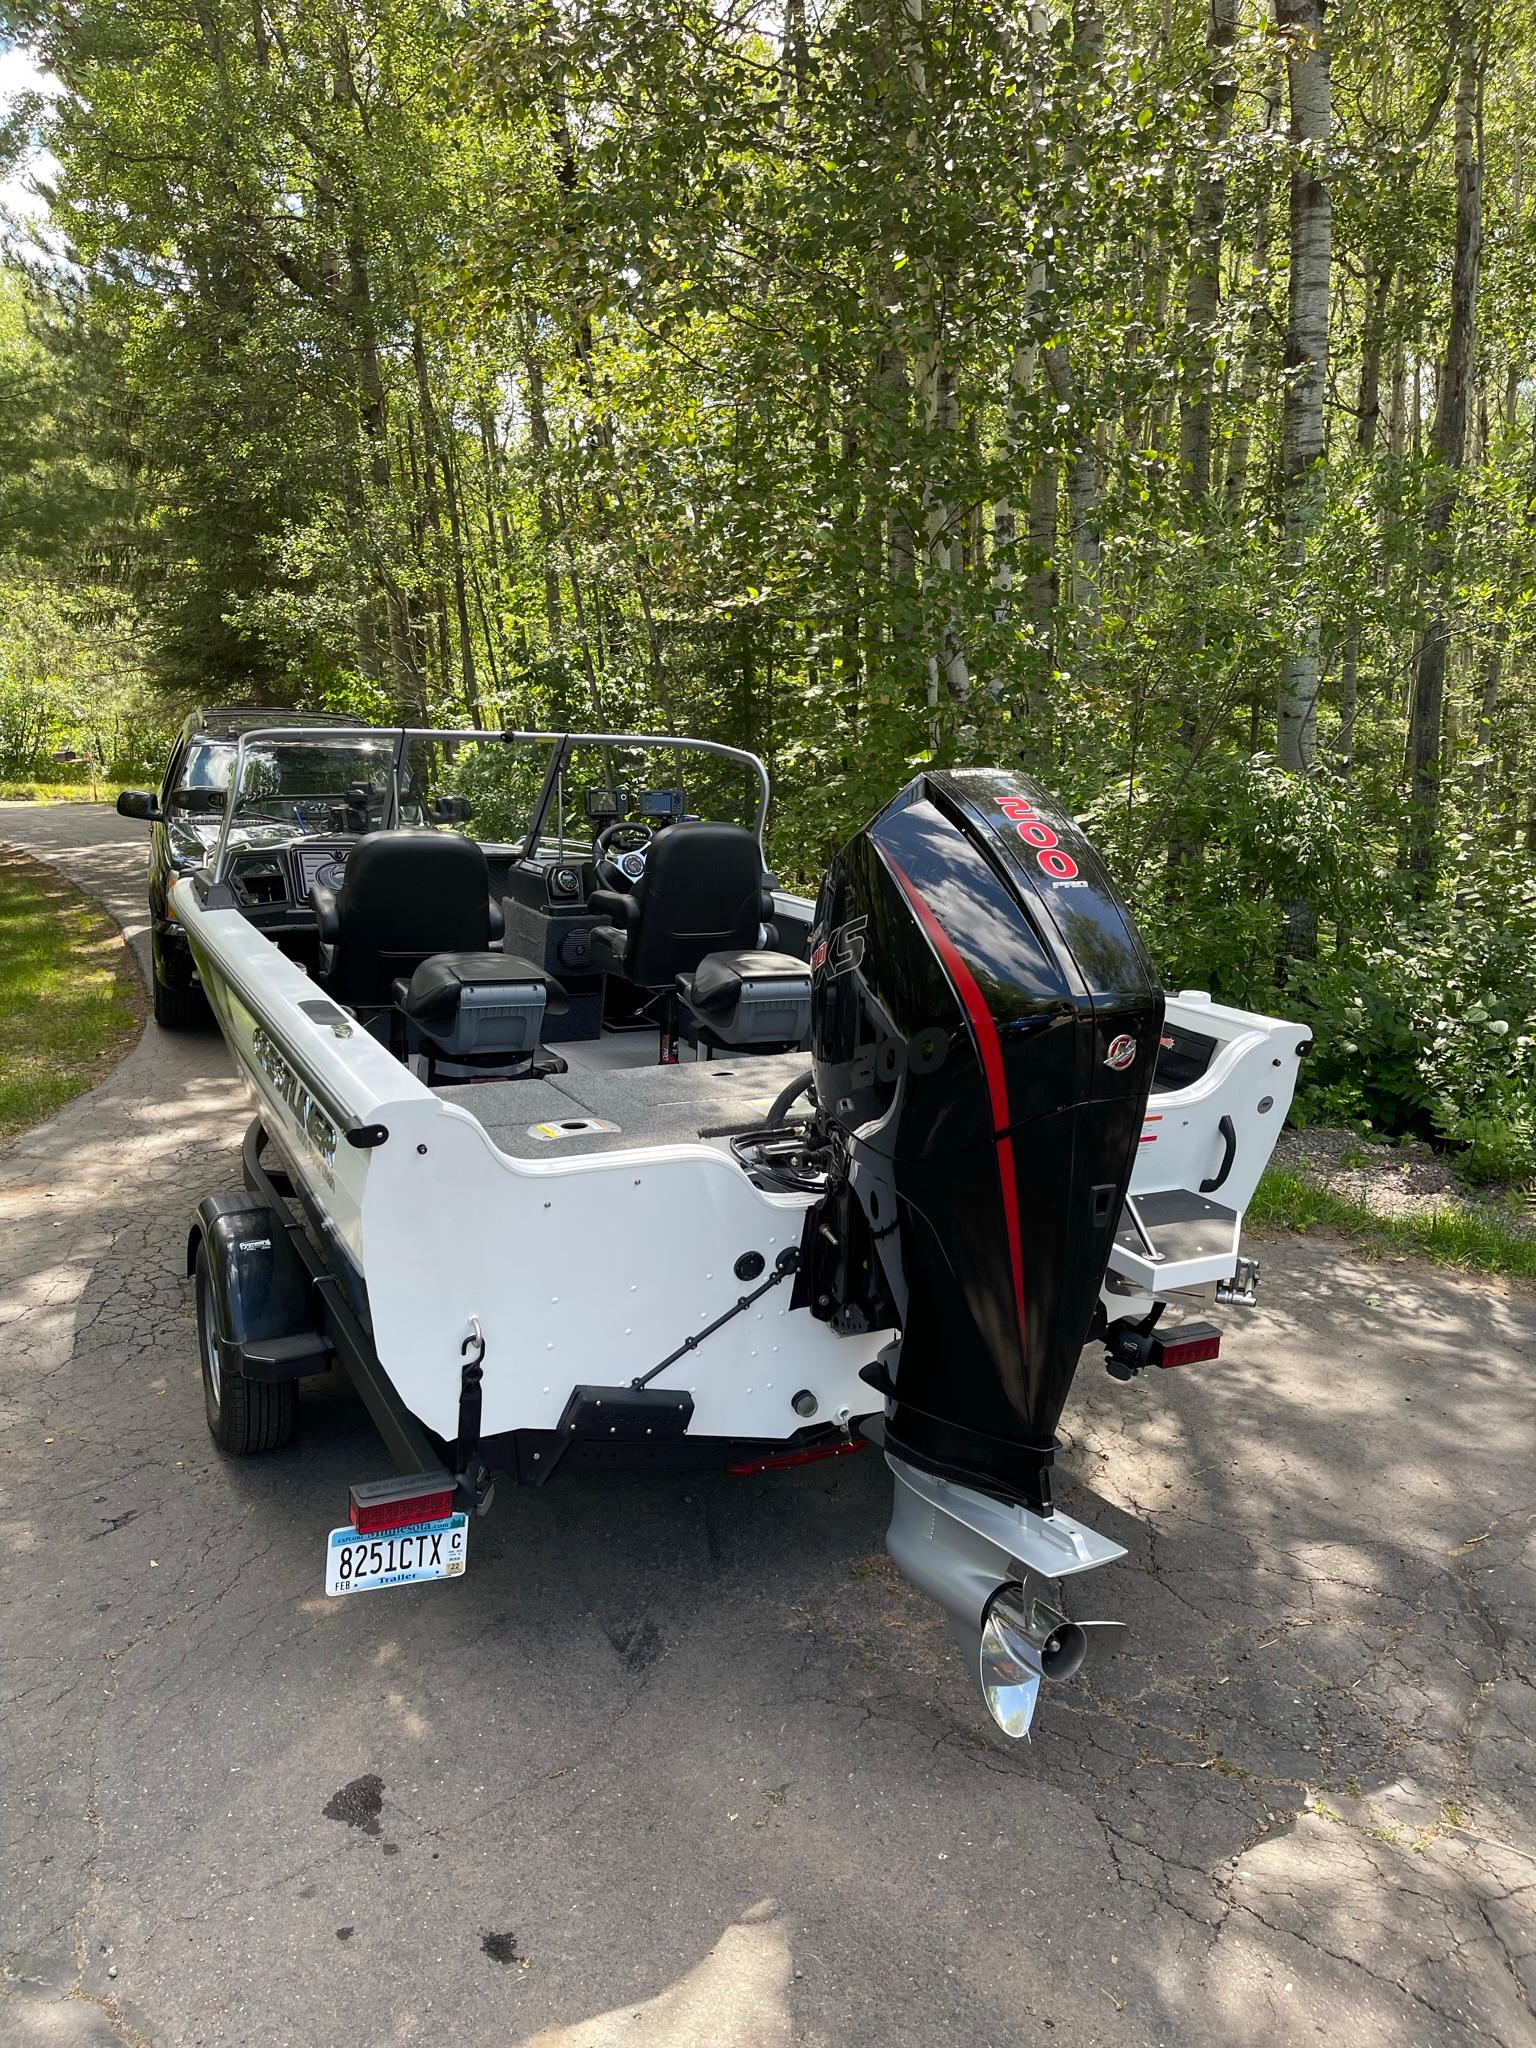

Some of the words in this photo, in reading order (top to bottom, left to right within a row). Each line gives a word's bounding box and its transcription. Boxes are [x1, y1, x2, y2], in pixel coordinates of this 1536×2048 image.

[951, 768, 1014, 778] MERCURY
[993, 796, 1079, 880] 200
[1052, 880, 1089, 889] PRO
[851, 1026, 951, 1090] 200
[451, 1533, 462, 1549] C
[340, 1533, 442, 1580] 8251CTX
[450, 1563, 460, 1571] 22
[378, 1572, 418, 1584] Trailer
[335, 1580, 351, 1591] FEB
